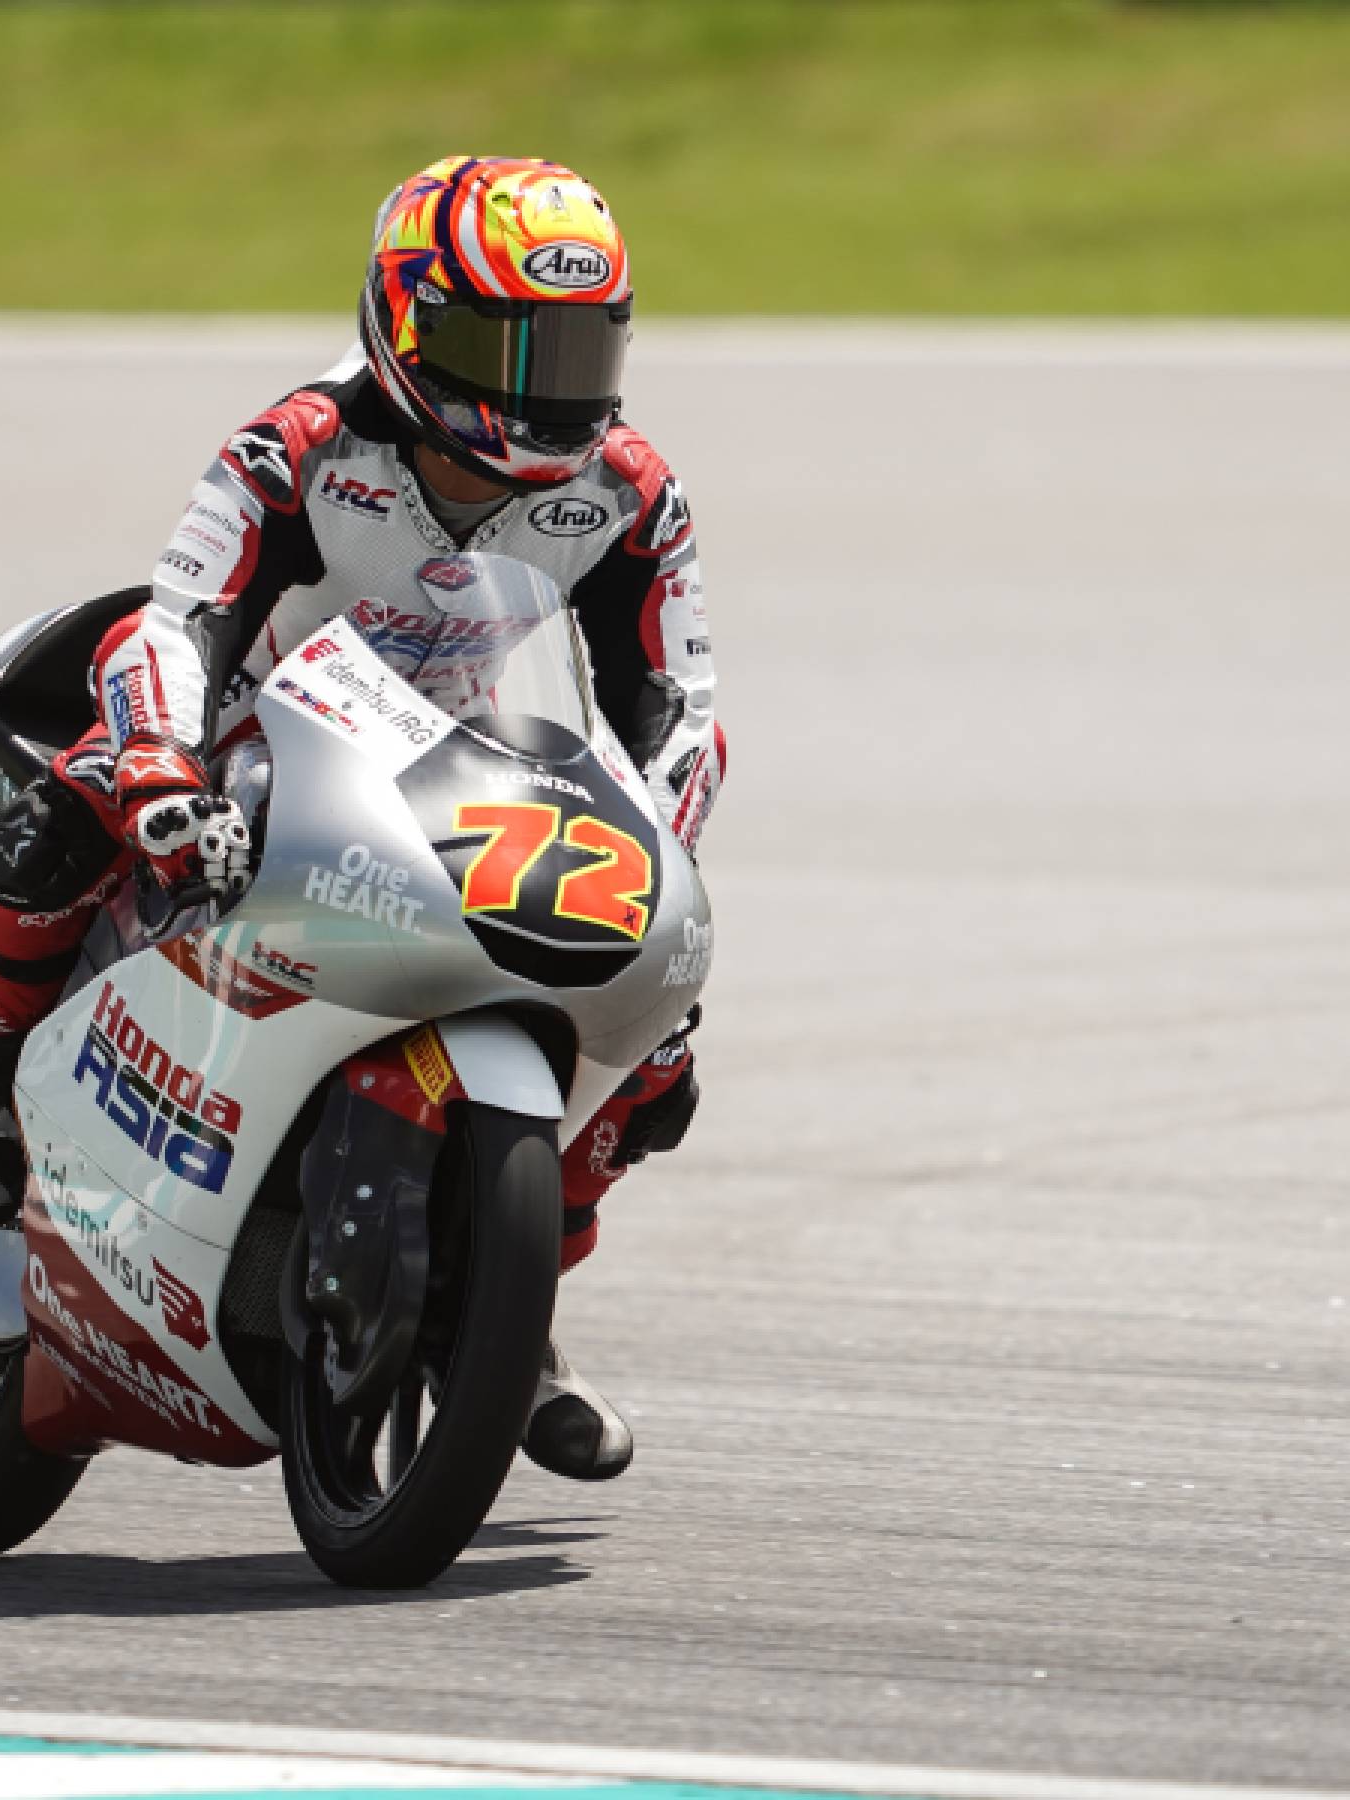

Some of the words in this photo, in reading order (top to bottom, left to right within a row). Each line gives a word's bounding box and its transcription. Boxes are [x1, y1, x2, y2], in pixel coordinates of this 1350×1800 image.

[539, 248, 601, 276] Arai
[319, 470, 397, 514] HRC
[544, 503, 596, 527] Arai
[322, 657, 404, 717] idemitsu
[486, 770, 595, 802] HONDA
[338, 845, 410, 893] One
[453, 803, 653, 943] 72
[251, 941, 318, 985] HRC
[92, 980, 244, 1136] Honda
[29, 1252, 85, 1343] One
